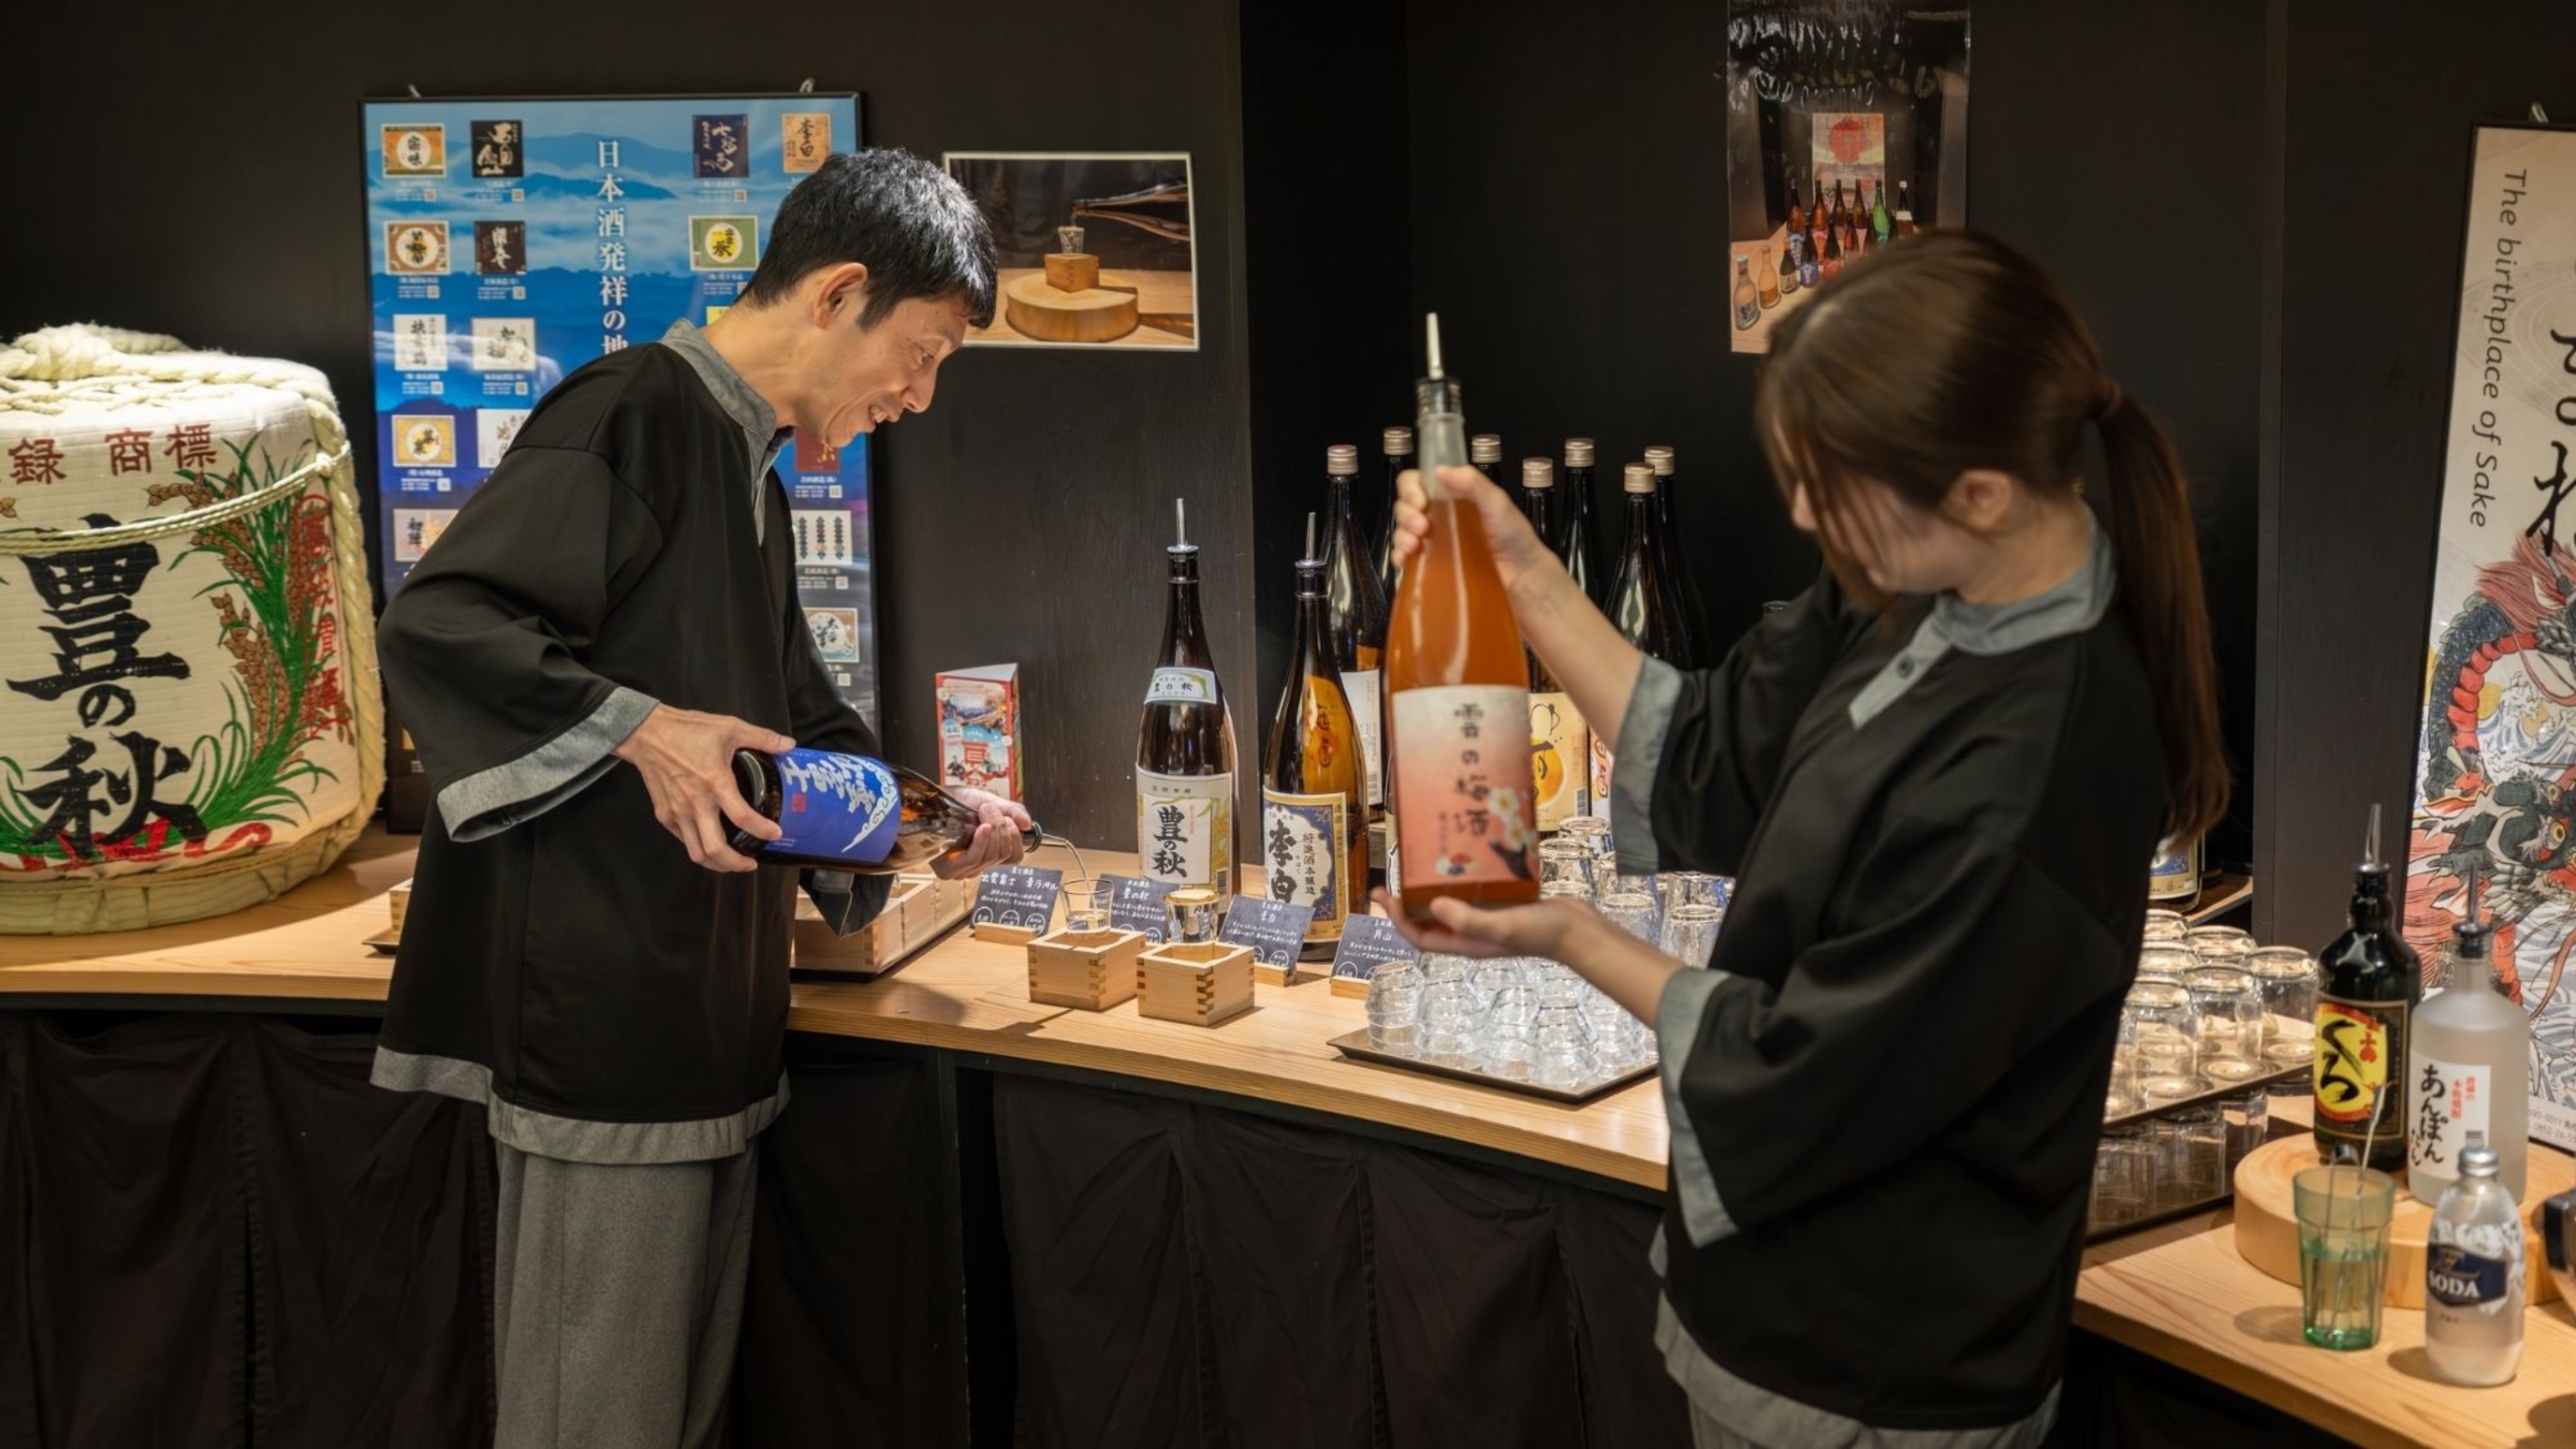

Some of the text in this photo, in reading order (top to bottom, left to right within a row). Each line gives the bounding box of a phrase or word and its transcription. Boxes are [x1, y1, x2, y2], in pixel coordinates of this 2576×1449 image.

[2469, 168, 2527, 528] The birthplace of Sake
[7, 513, 208, 859] 豊の秋
[1151, 805, 1189, 878] 豊の秋
[1268, 818, 1298, 905] 李白
[2421, 1063, 2450, 1164] あんぽん
